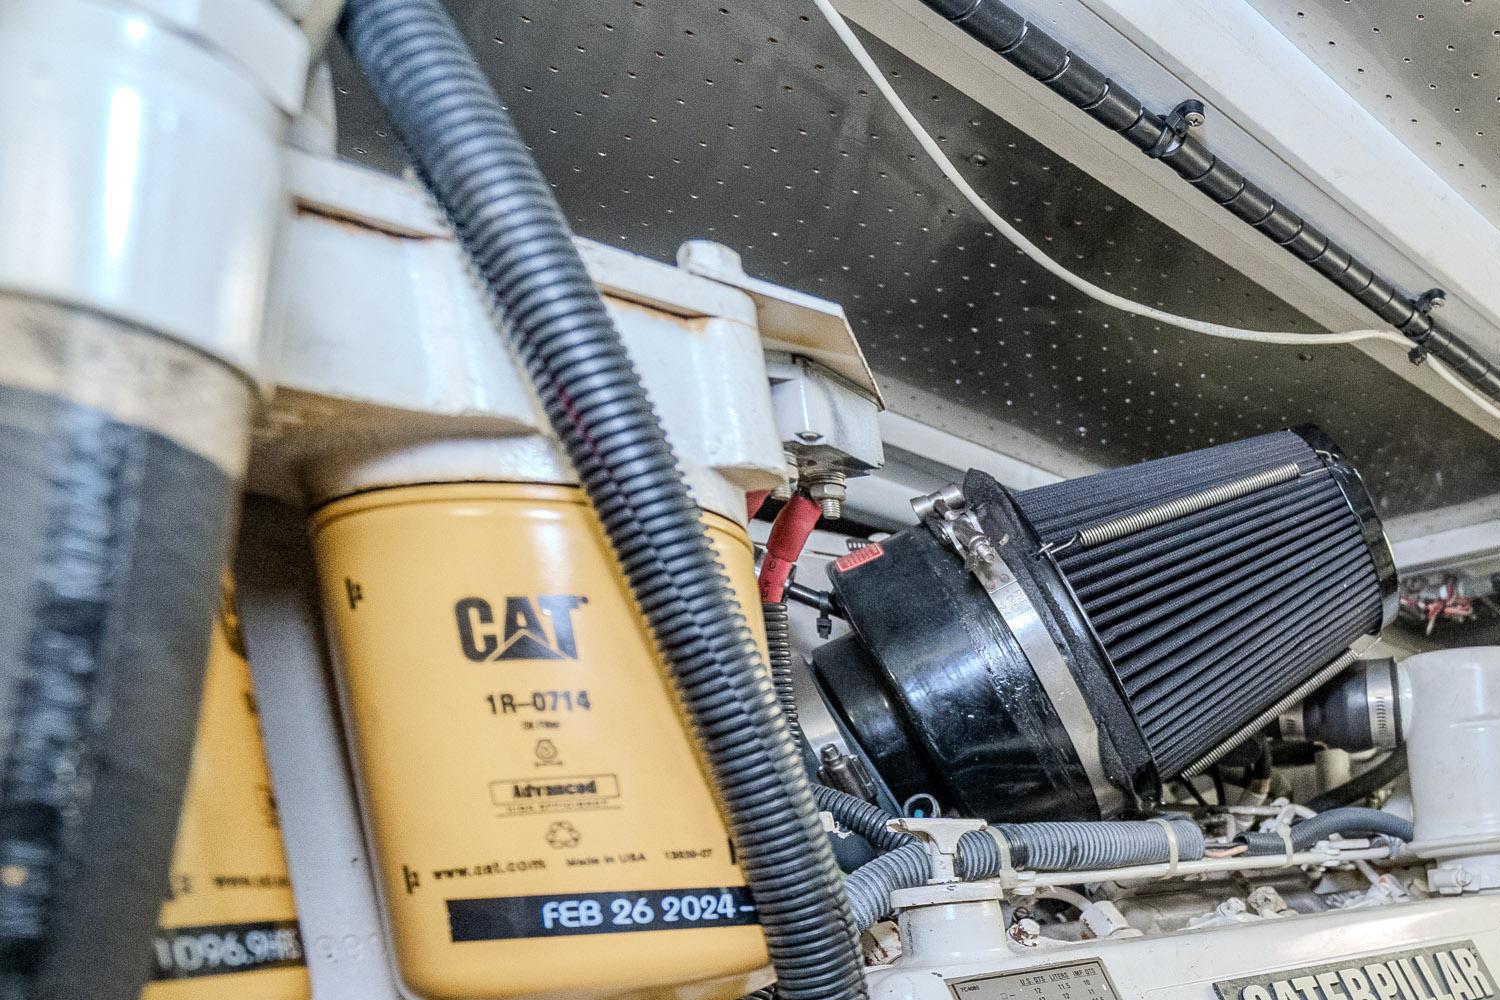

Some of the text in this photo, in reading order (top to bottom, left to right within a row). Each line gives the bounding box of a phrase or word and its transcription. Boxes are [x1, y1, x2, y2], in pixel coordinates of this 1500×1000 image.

[454, 596, 579, 662] CAT
[486, 690, 591, 714] 1R-0714
[513, 780, 597, 798] Advanced
[432, 859, 546, 880] www.cat.com
[542, 899, 604, 929] FEB
[610, 897, 655, 926] 26
[1049, 972, 1069, 981] LITERS
